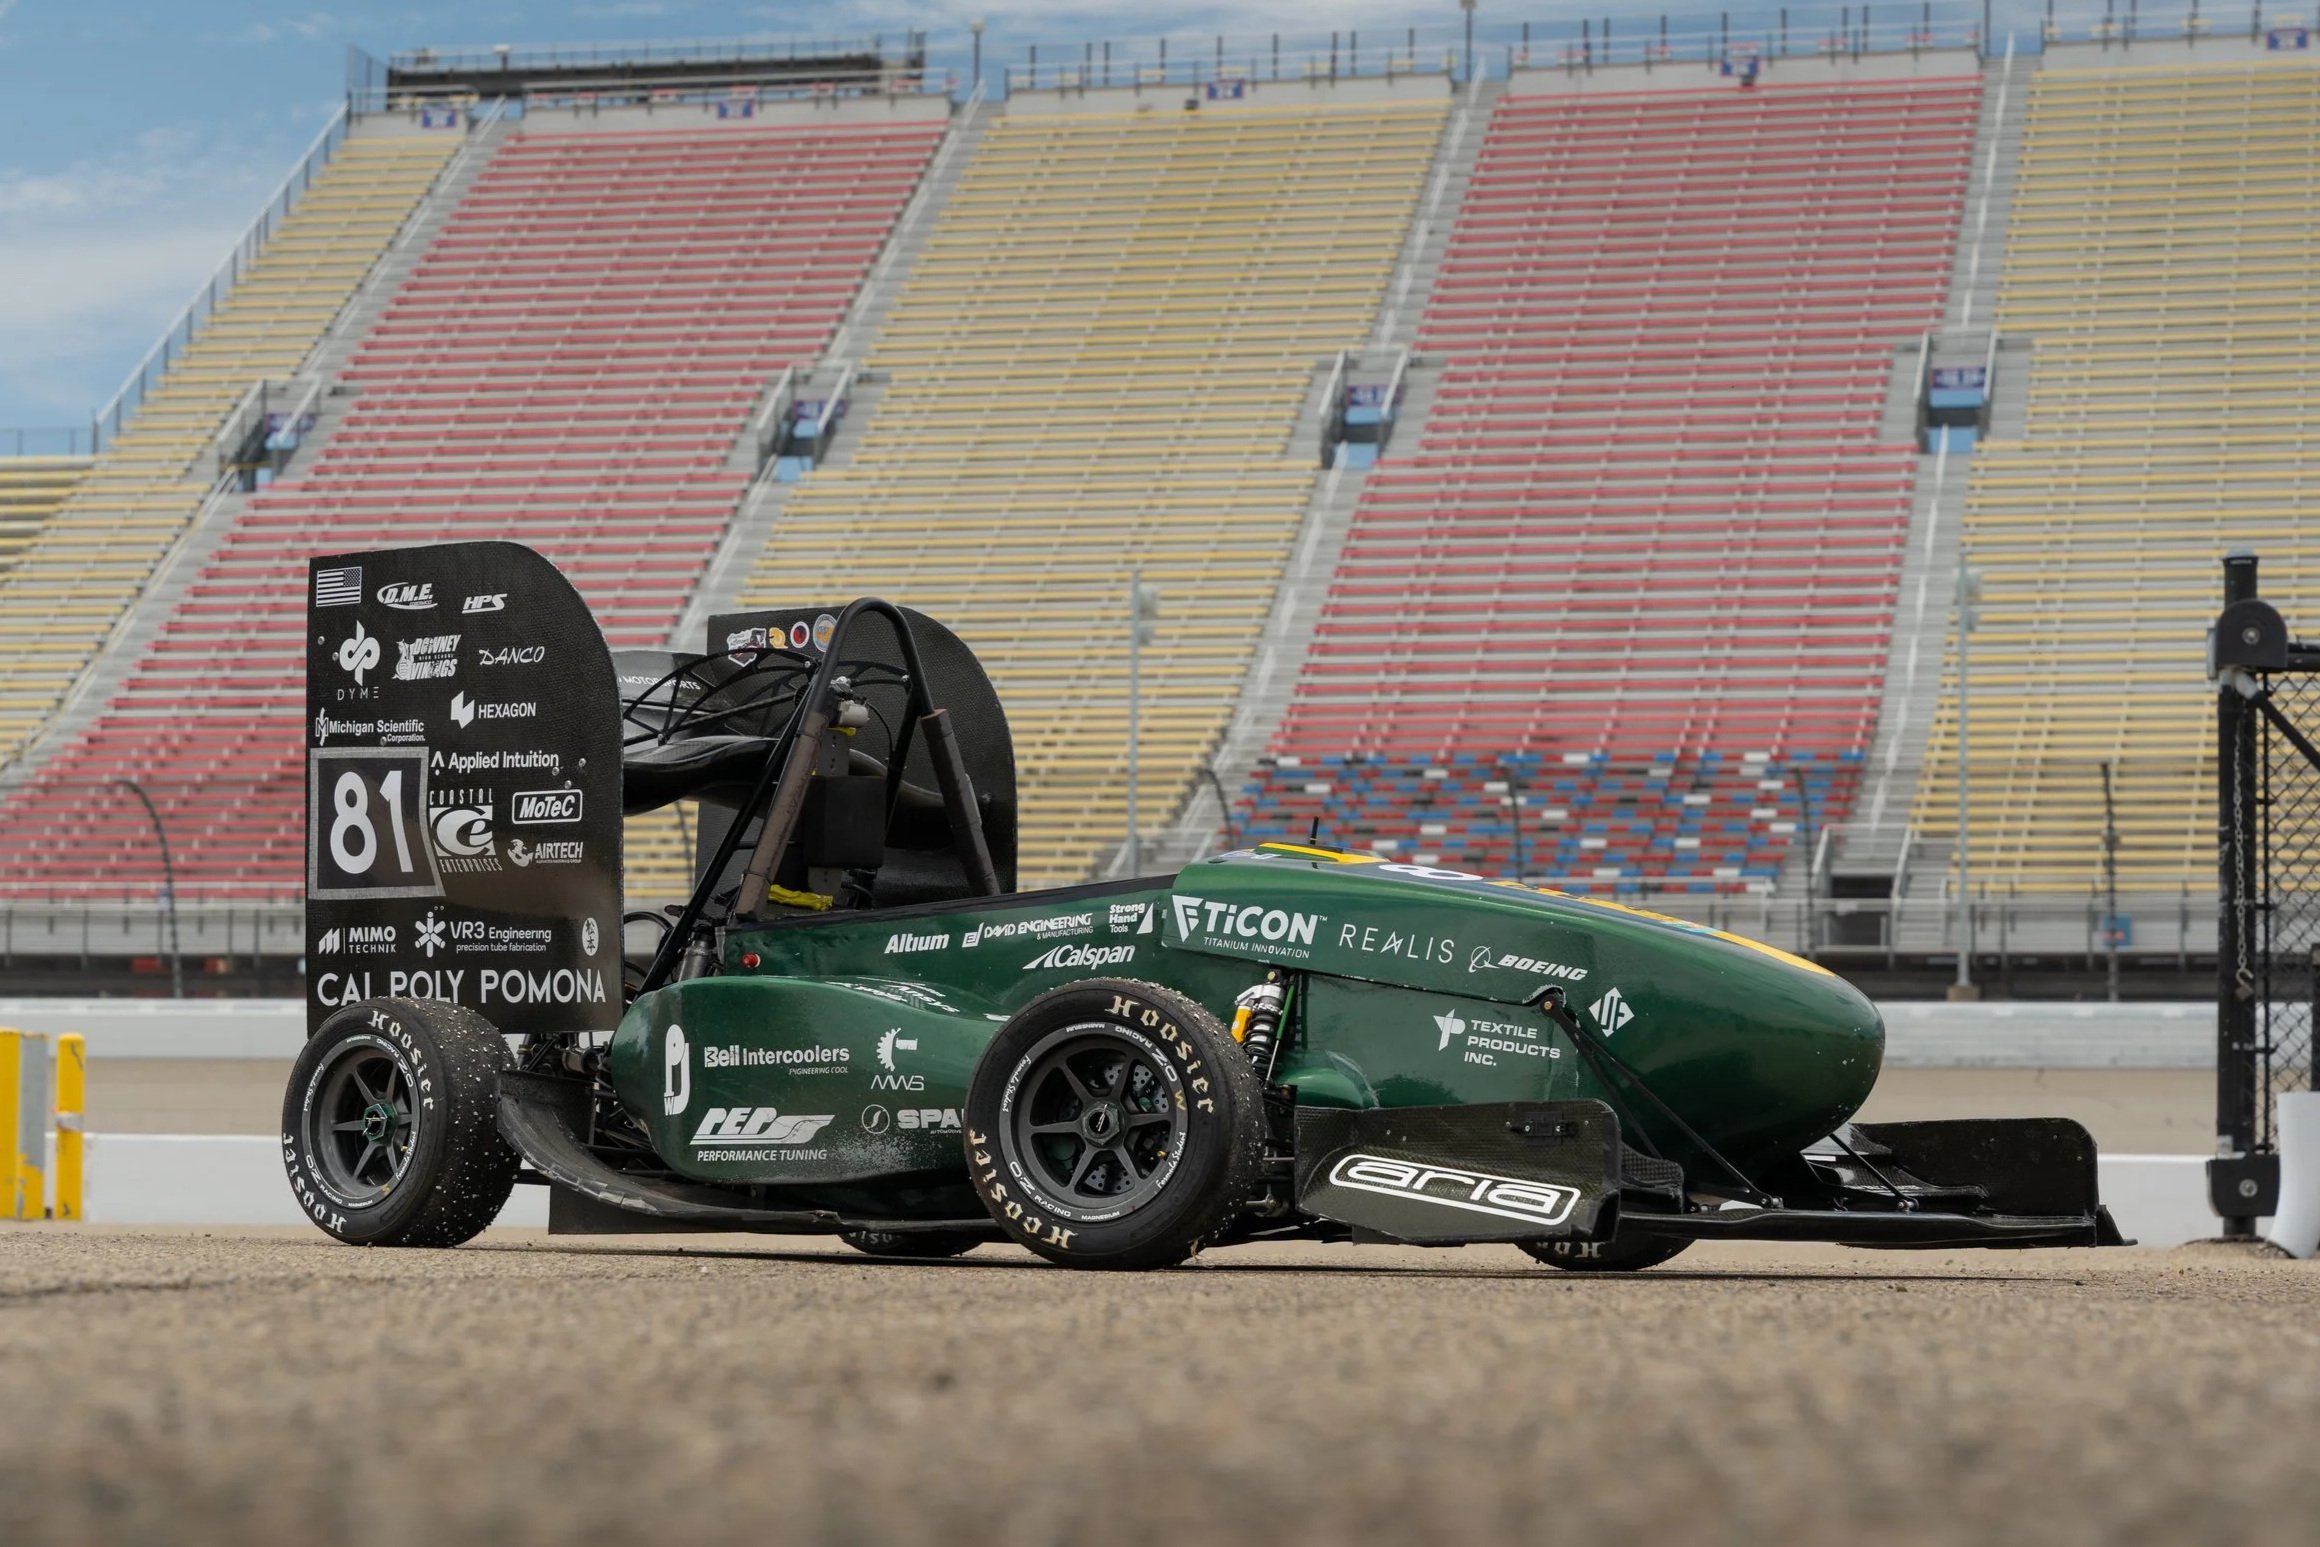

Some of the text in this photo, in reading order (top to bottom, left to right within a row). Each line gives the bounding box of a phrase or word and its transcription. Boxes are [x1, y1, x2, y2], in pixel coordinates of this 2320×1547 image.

[384, 583, 433, 604] D.M.E.
[463, 594, 507, 611] HPS
[413, 634, 462, 655] DOWNEY
[479, 646, 545, 665] DANCO
[338, 685, 379, 700] DYME
[479, 702, 536, 718] HEXAGON
[330, 719, 424, 736] Michigan Scientific
[448, 750, 559, 773] Applied Intuition
[430, 788, 493, 807] COASTAL
[520, 796, 575, 818] MoTeC
[330, 771, 413, 874] 81
[535, 842, 583, 859] AIRTECH
[438, 858, 502, 874] ENTERPRISES
[1109, 903, 1146, 915] Strong
[1109, 914, 1138, 924] Hand
[349, 926, 396, 942] MIMO
[450, 921, 551, 942] VR3 Engineering
[984, 913, 1093, 938] DAVID ENGINEERING
[1043, 927, 1094, 940] MANUFACTURING
[1109, 924, 1129, 933] Tools
[349, 944, 396, 953] TECHNIK
[456, 940, 548, 953] precision tube fabrication
[884, 934, 949, 953] Altium
[1202, 935, 1311, 960] TITANIUM INNOVATION
[1054, 943, 1135, 970] Calspan
[1496, 955, 1587, 980] BOEING
[390, 969, 465, 1000] POLY
[481, 969, 606, 1003] POMONA
[1114, 1025, 1153, 1049] RACING
[1469, 1020, 1537, 1039] TEXTILE
[704, 1045, 850, 1067] Bell Intercoolers
[1105, 995, 1215, 1114] Hoosier
[1465, 1034, 1560, 1060] PRODUCTS
[367, 1009, 435, 1111] Hoosier
[1464, 1052, 1496, 1066] INC.
[829, 1064, 849, 1075] COOL
[897, 1108, 965, 1129] SPA
[696, 1147, 829, 1163] PERFORMANCE TUNING
[281, 1131, 349, 1234] Hoosier
[969, 1129, 1079, 1250] Hoosier
[1033, 1193, 1072, 1218] RACING
